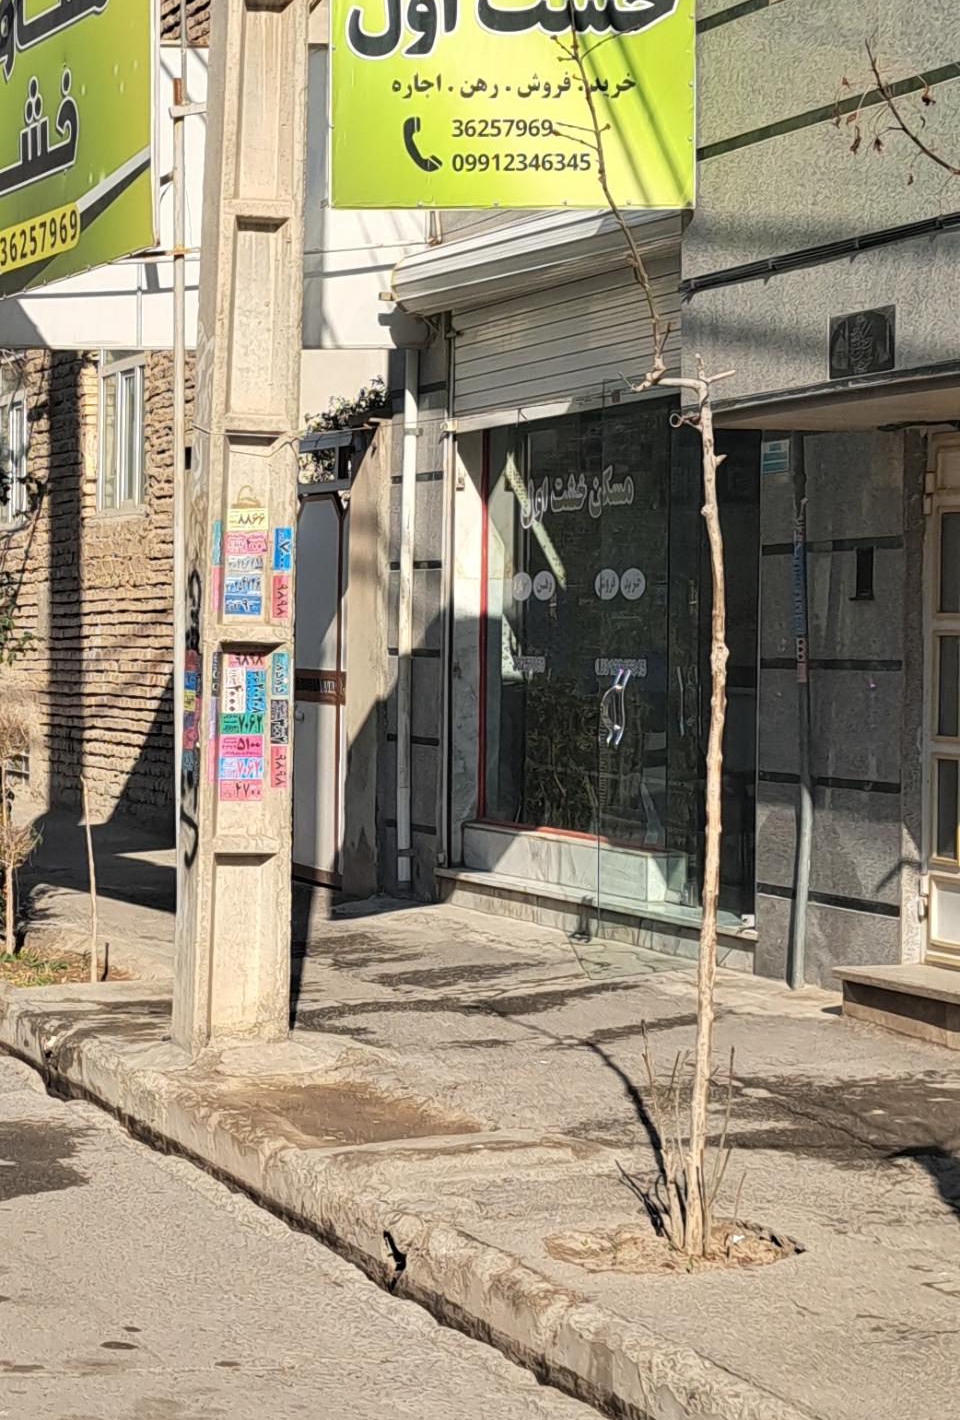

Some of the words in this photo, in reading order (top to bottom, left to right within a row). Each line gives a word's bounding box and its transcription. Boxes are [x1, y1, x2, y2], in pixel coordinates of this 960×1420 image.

[391, 72, 441, 99] اجاره
[460, 78, 498, 98] رهن
[517, 73, 571, 98] فروش
[451, 119, 553, 137] 36257969
[452, 154, 591, 171] 09912346345
[0, 210, 77, 266] 36257969
